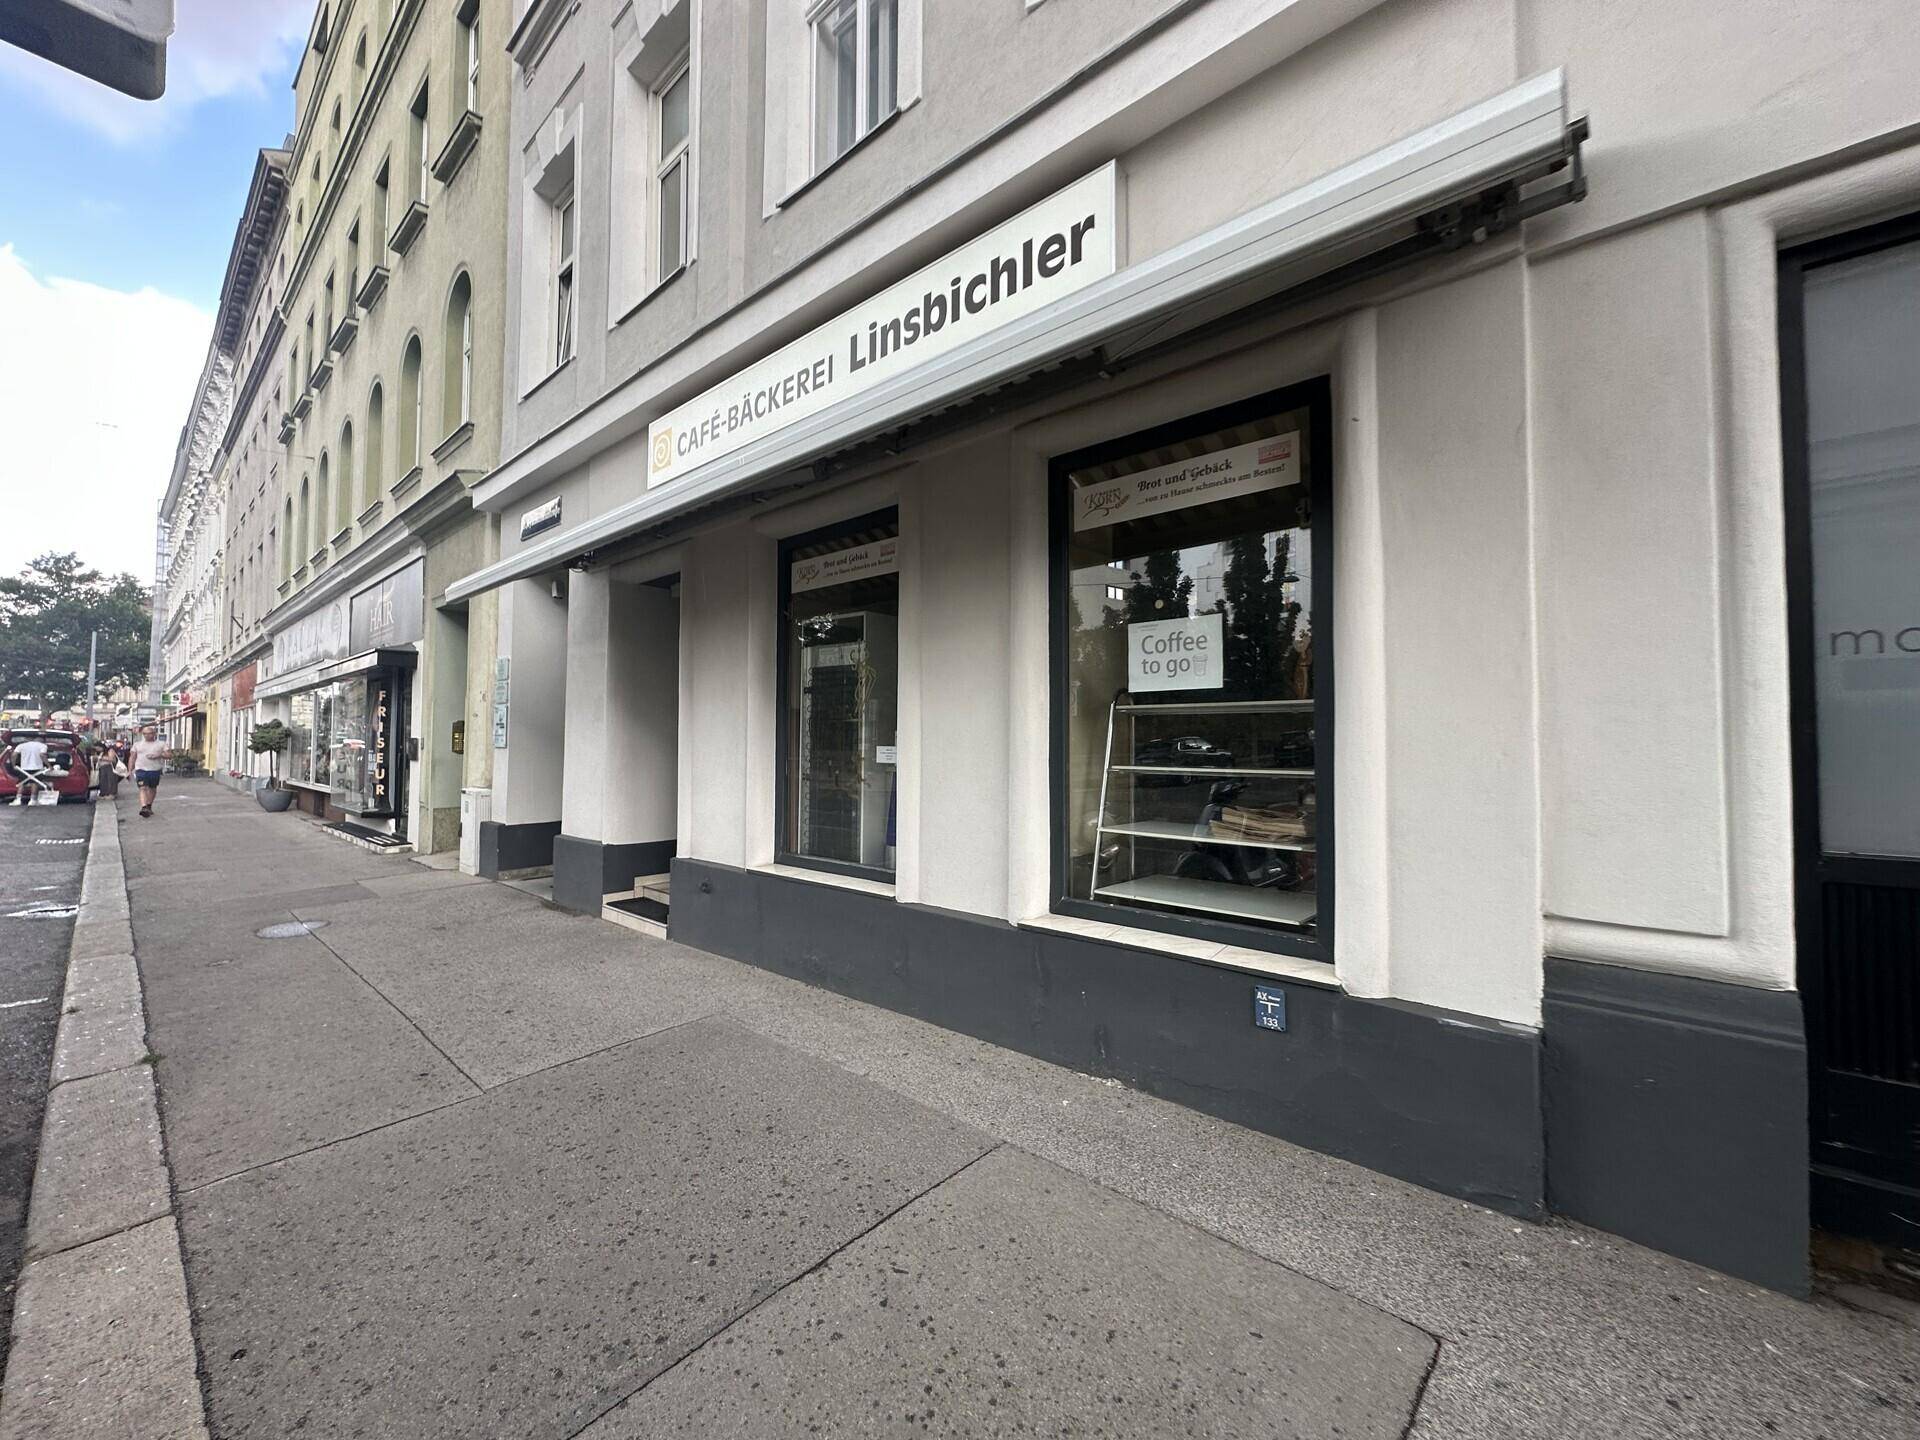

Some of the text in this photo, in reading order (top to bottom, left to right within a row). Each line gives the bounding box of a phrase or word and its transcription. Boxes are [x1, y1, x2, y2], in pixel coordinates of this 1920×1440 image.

[677, 214, 1095, 457] CAFÉ-BÄCKEREI Linsbichler
[1137, 459, 1233, 492] Brot und Gebäck
[369, 600, 394, 633] HAIR
[1141, 630, 1208, 654] Coffee
[1141, 658, 1191, 678] to go
[375, 690, 387, 796] FRISEUR
[1256, 992, 1268, 1001] AX
